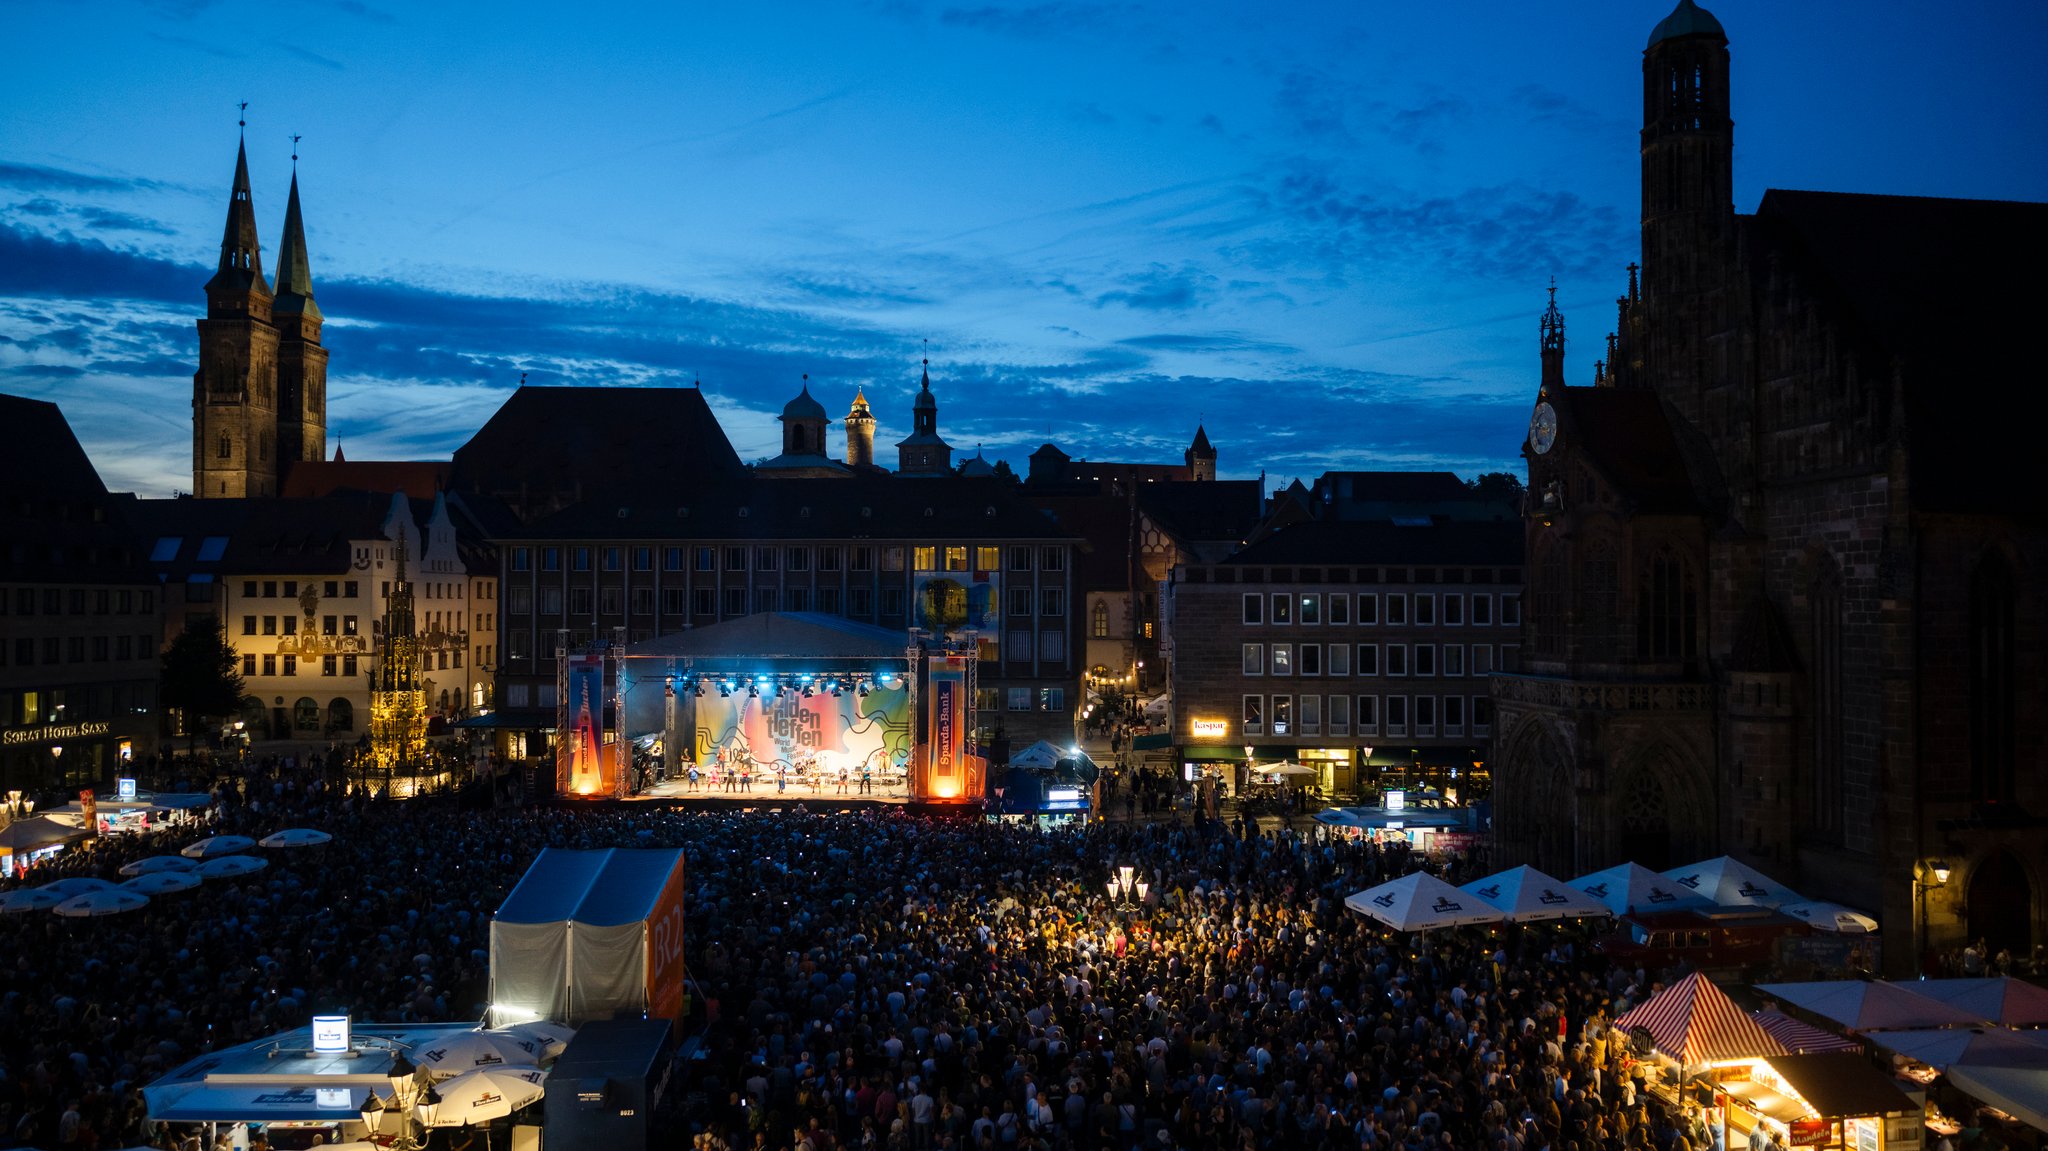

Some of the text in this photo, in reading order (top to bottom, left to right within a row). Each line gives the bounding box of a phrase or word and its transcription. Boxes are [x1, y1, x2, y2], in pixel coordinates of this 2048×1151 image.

[940, 692, 950, 765] Sparda-Bank
[1194, 721, 1226, 731] kaspar
[1632, 1030, 1652, 1053] GRILL
